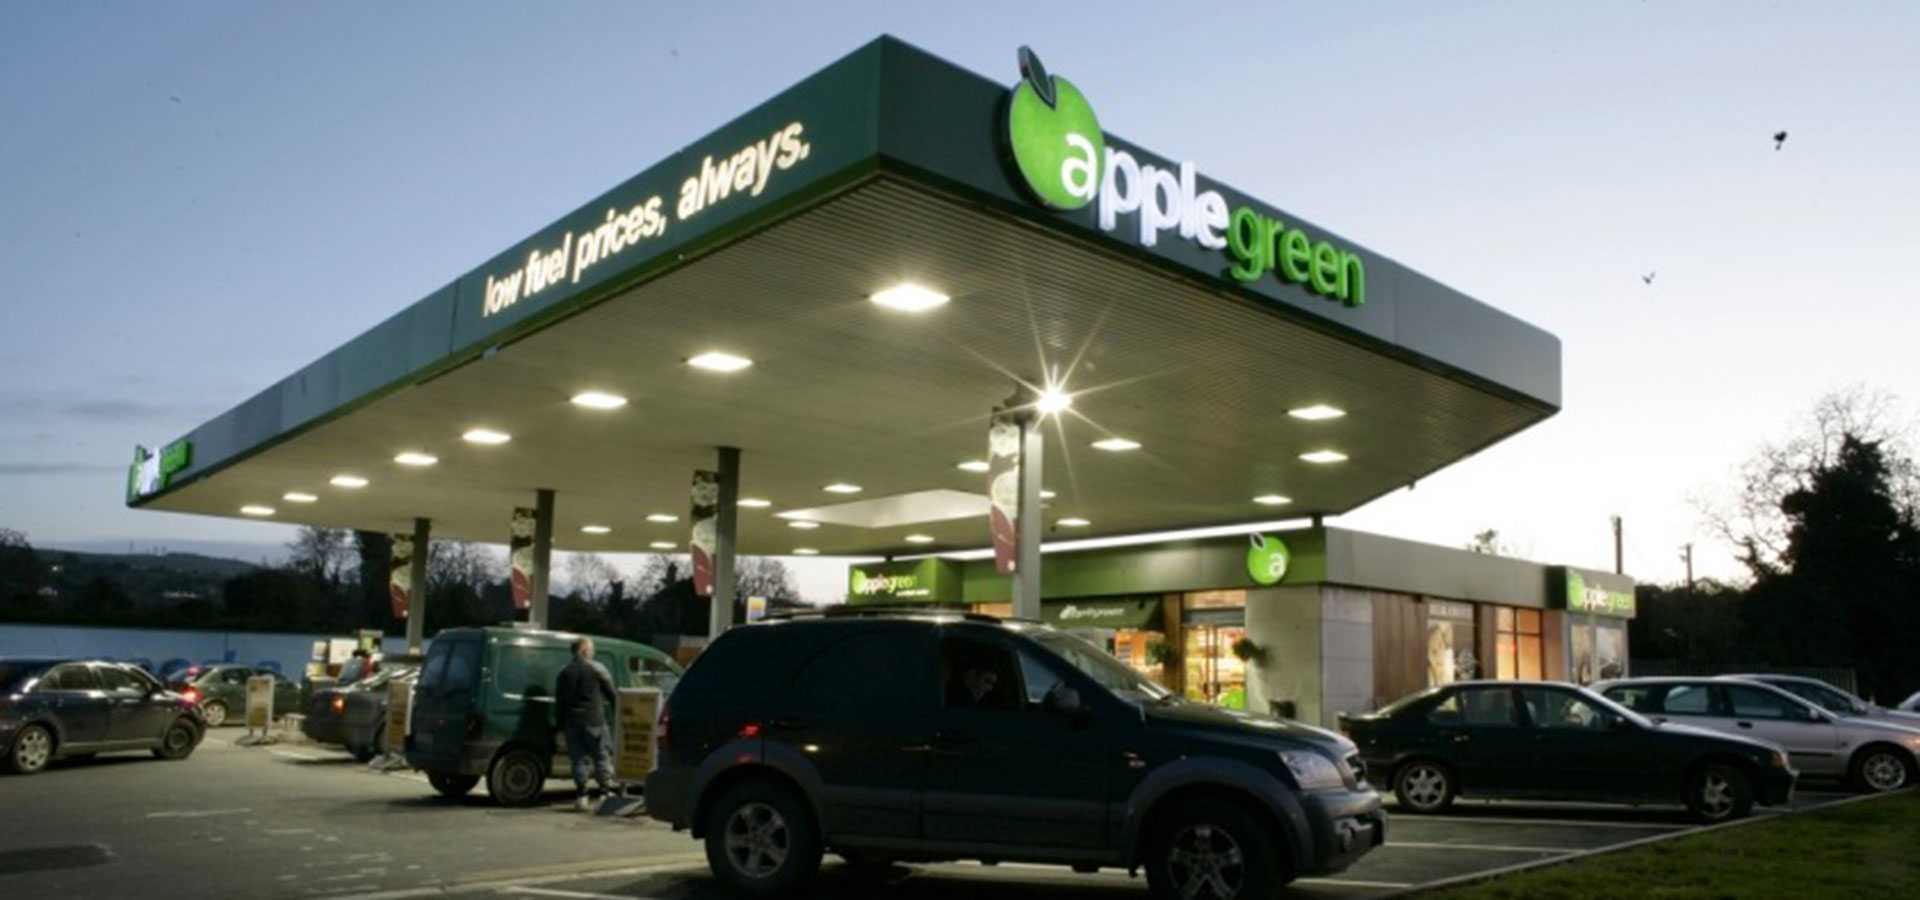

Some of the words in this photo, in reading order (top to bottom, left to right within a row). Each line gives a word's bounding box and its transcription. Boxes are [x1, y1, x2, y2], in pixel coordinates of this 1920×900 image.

[483, 275, 522, 317] low
[524, 232, 573, 297] fuel
[572, 195, 667, 284] prices,
[677, 121, 811, 219] always.
[1060, 132, 1365, 305] applegreen
